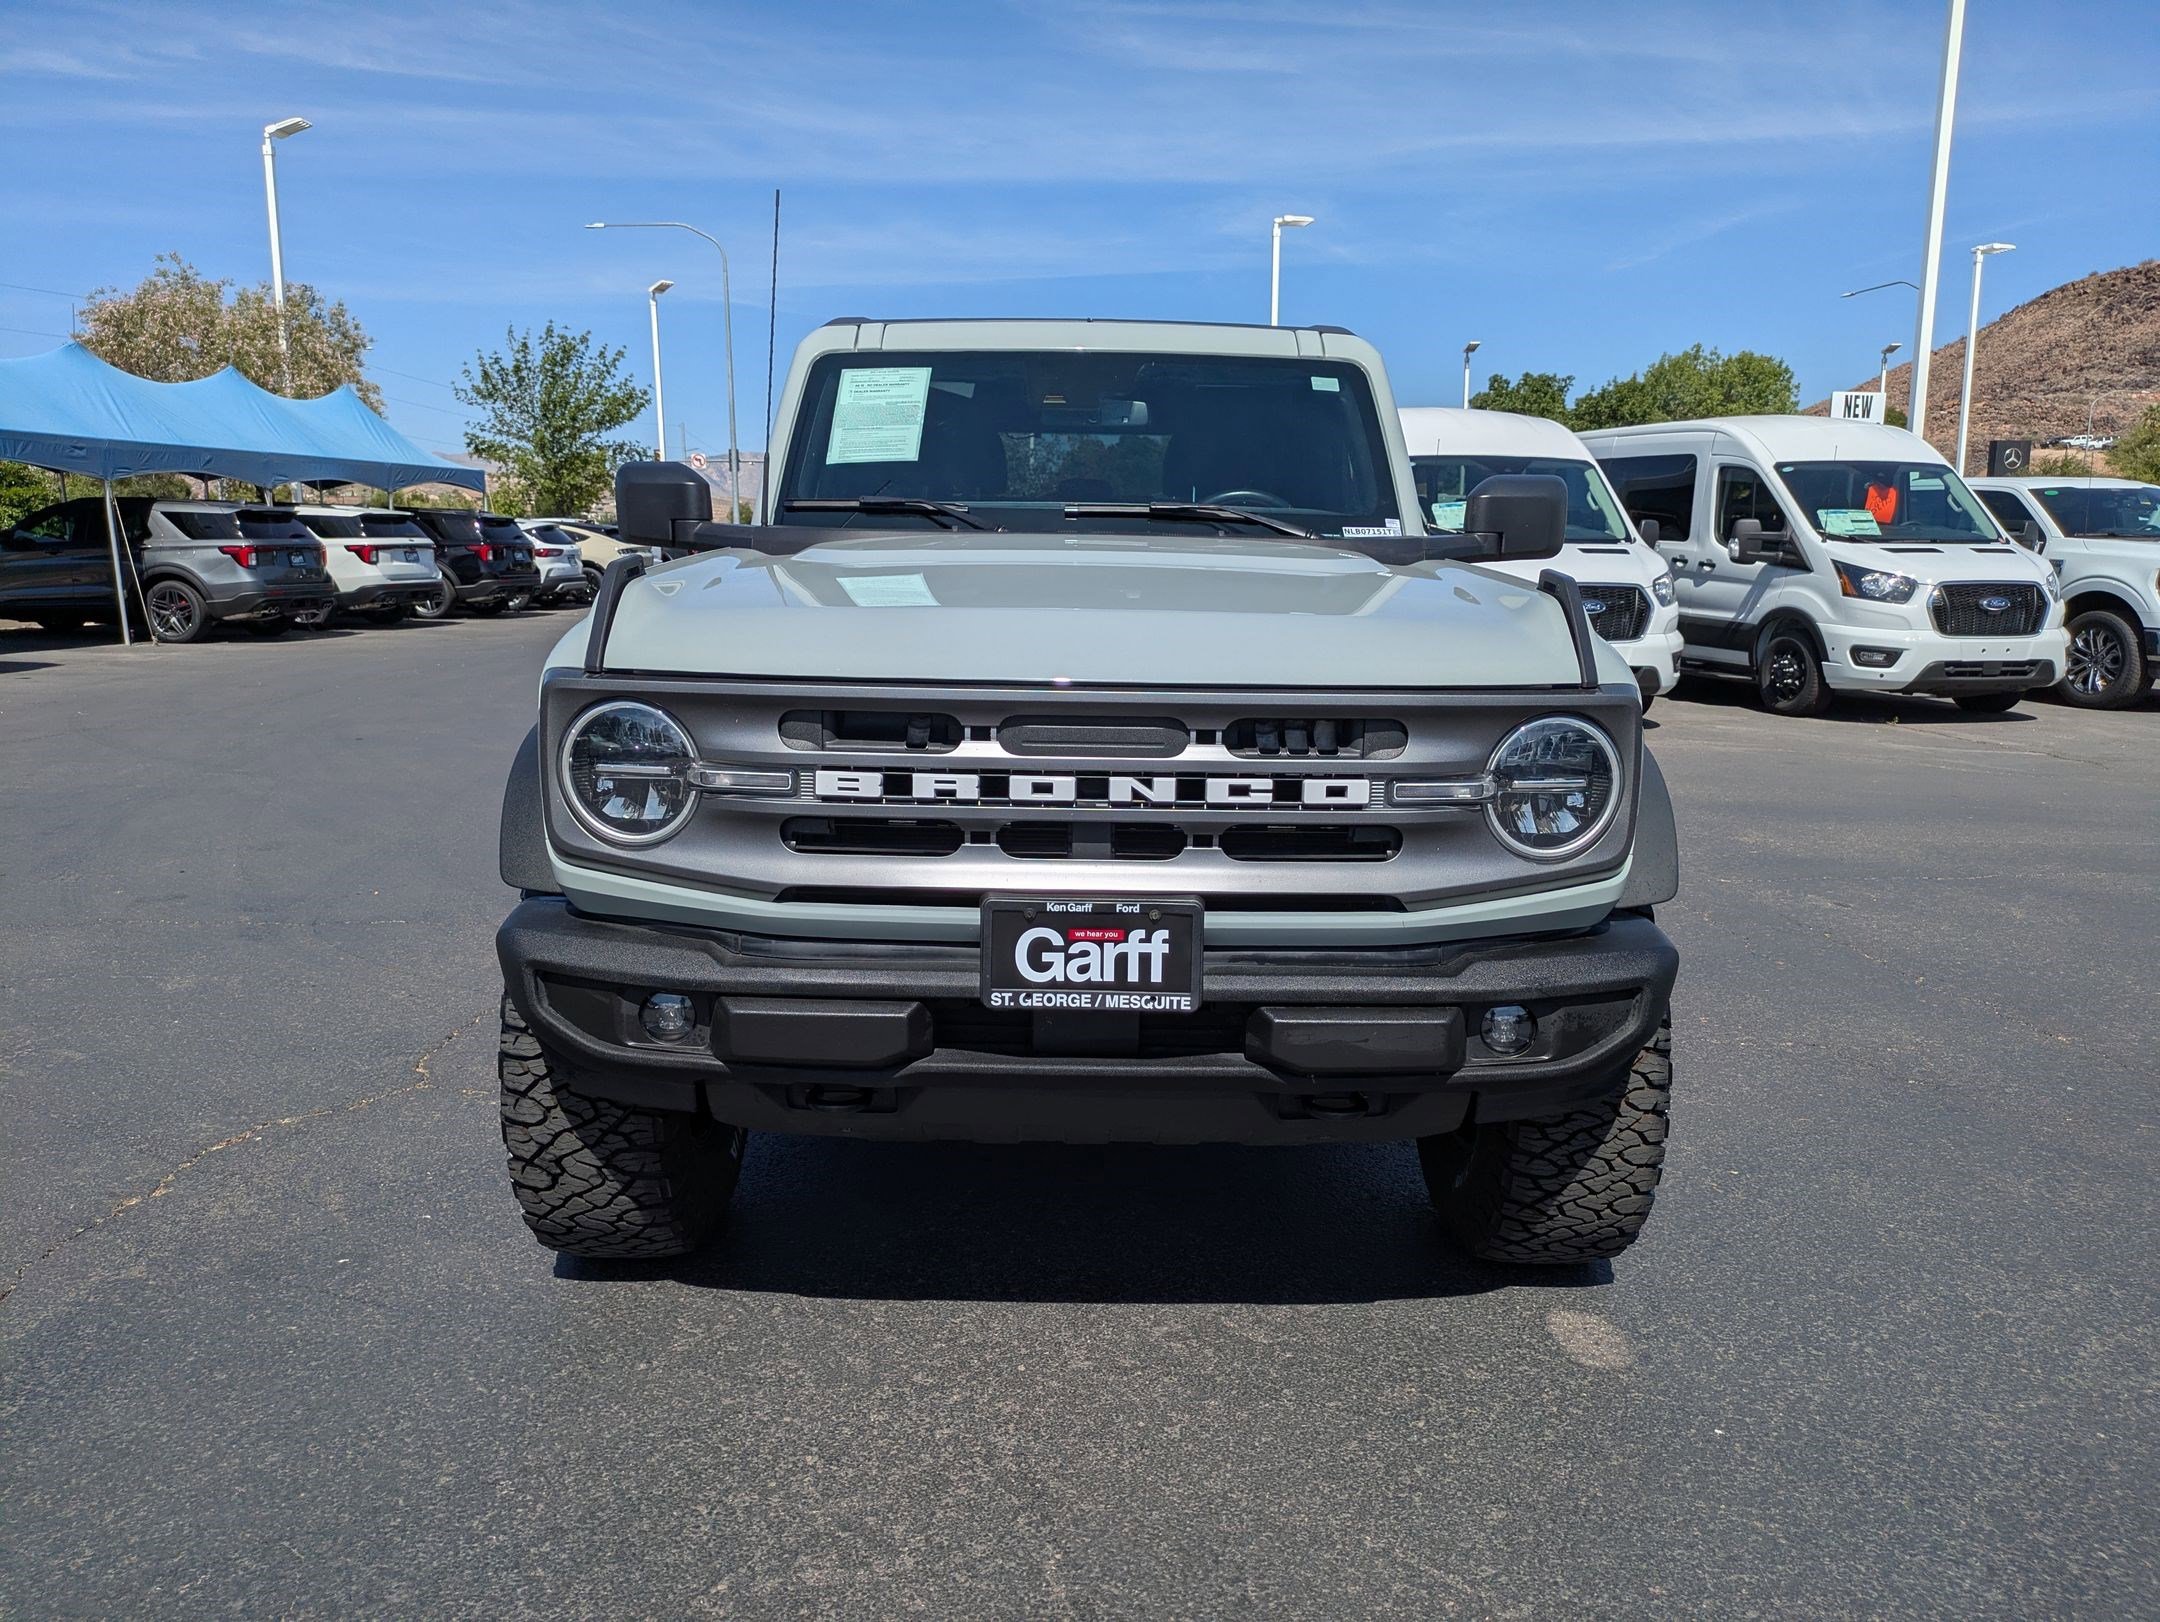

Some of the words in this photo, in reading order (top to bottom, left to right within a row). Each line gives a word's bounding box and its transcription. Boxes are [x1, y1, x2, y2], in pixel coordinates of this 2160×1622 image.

[1843, 395, 1873, 418] NEW
[815, 770, 1370, 804] BRONCO
[1047, 903, 1066, 912] Ken
[1067, 903, 1093, 913] Garff
[1116, 903, 1140, 913] Ford
[1015, 927, 1169, 983] Garff
[990, 992, 1014, 1006] ST.
[1019, 993, 1092, 1008] GEORGE
[1094, 994, 1103, 1008] /
[1105, 994, 1191, 1010] MESQUITE
